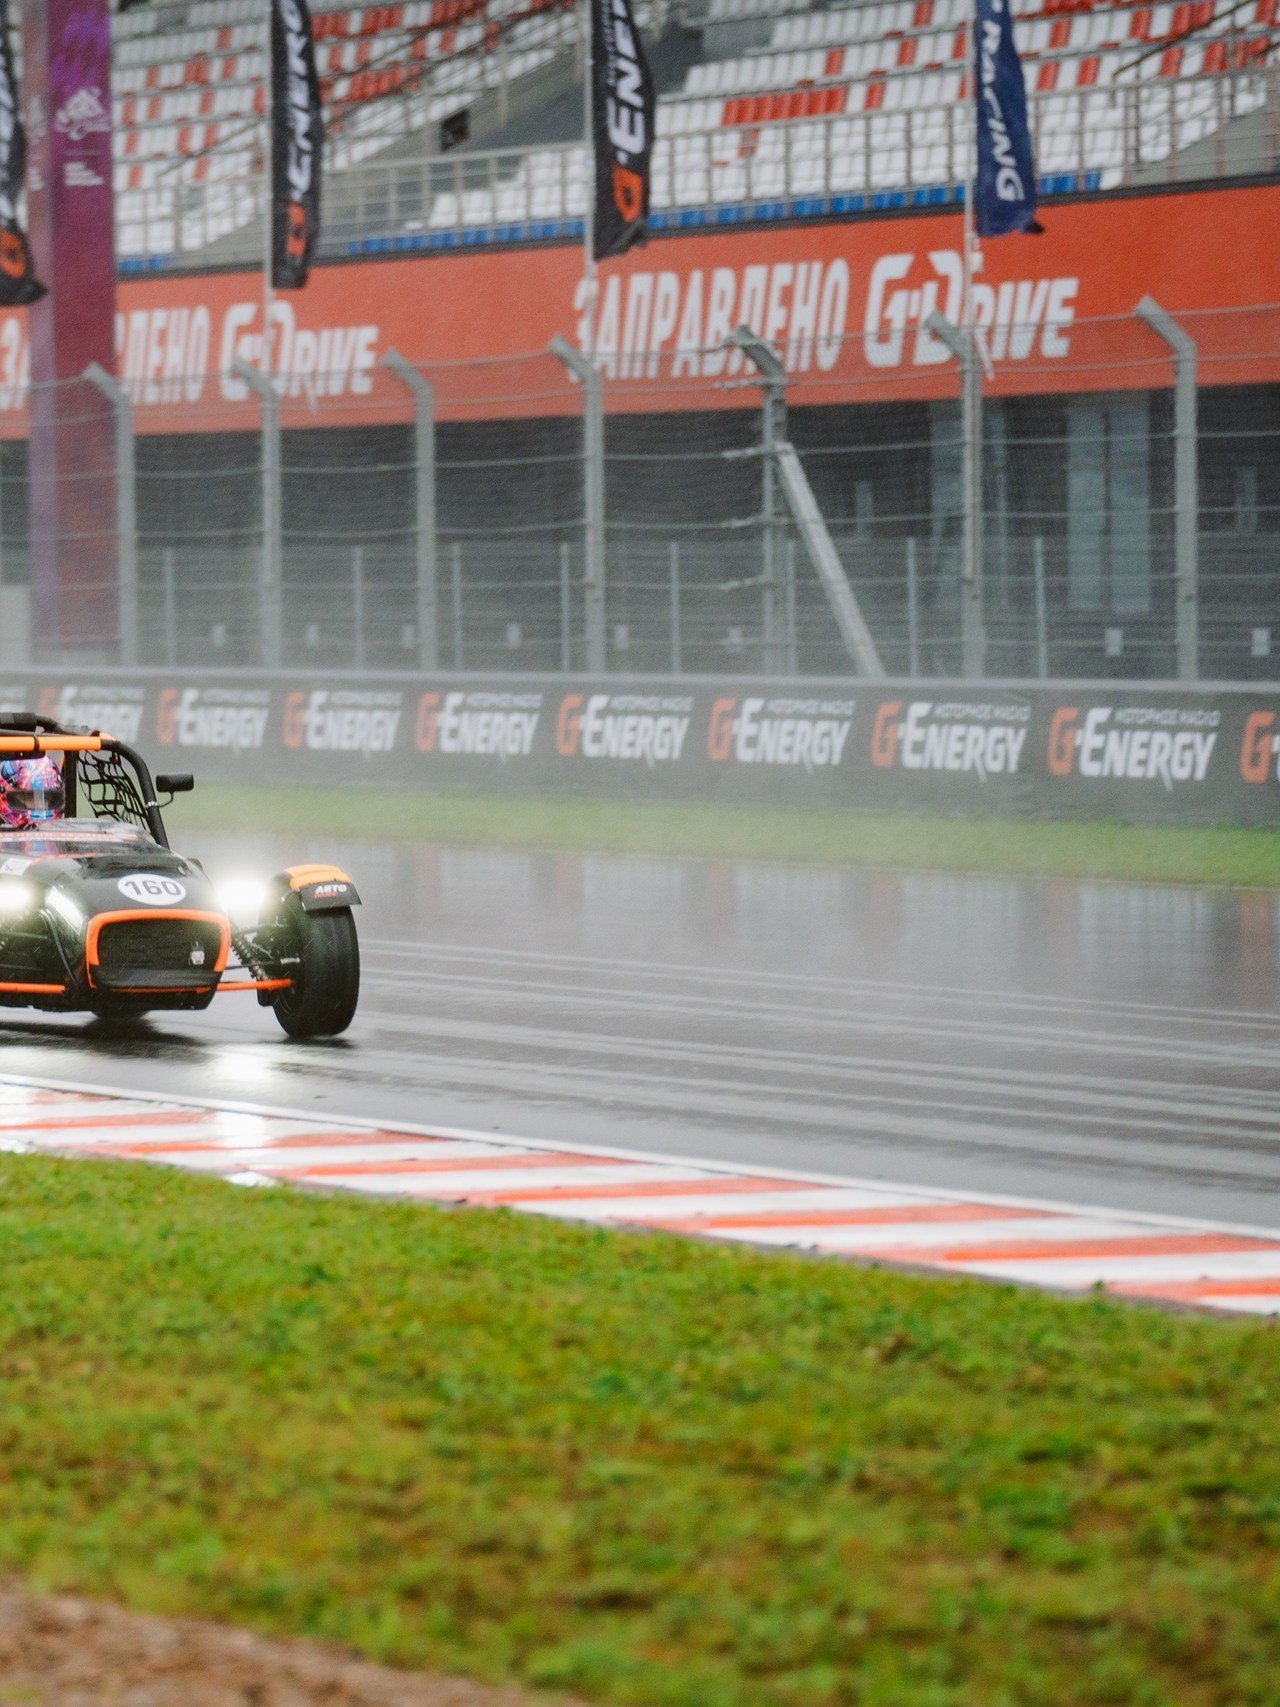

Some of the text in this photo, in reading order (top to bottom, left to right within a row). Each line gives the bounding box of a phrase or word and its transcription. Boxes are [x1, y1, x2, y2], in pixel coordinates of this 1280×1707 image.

[568, 258, 849, 383] ЗАПРАВЛЕНО
[415, 692, 541, 763] G-ENERGY
[555, 694, 691, 767] G-ENERGY
[706, 698, 852, 775] G-ENERGY
[872, 701, 1027, 783] G-ENERGY
[1047, 707, 1218, 791] G-ENERGY
[124, 880, 182, 896] 160
